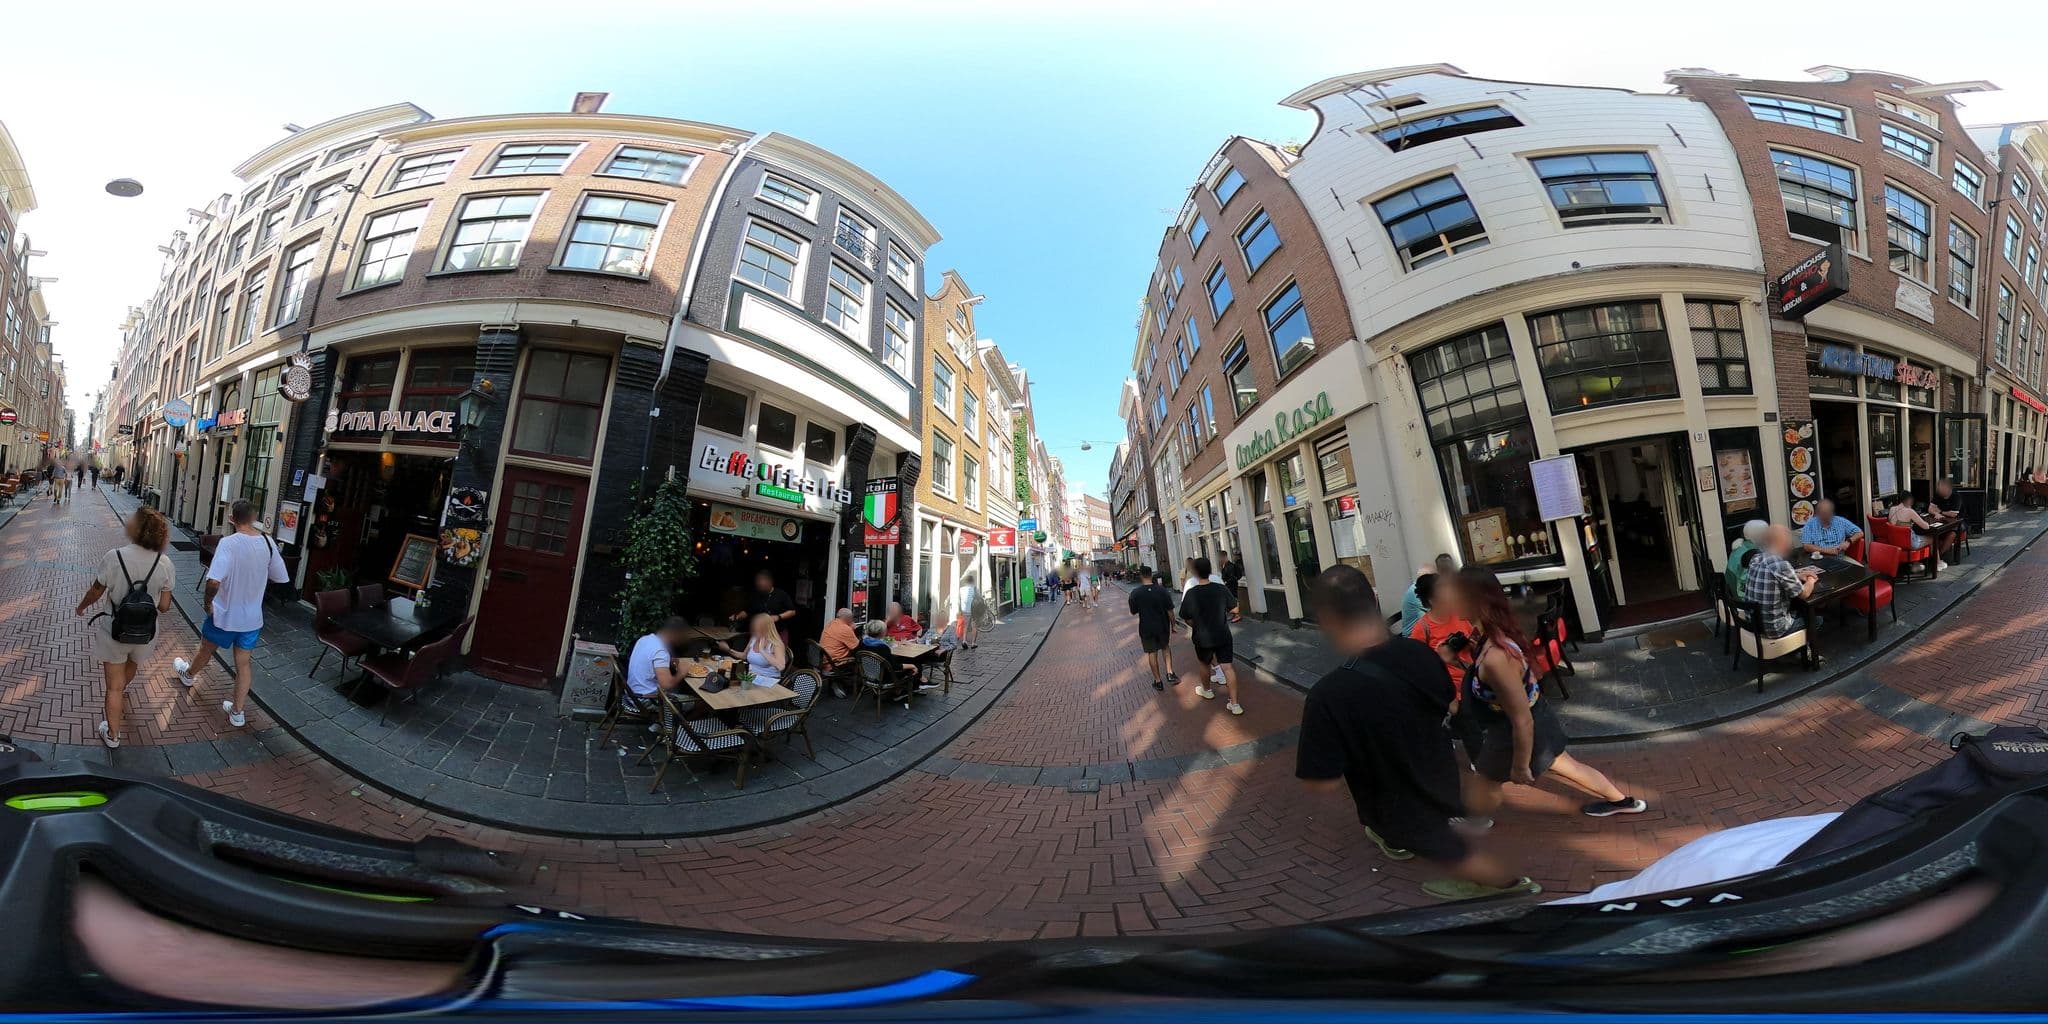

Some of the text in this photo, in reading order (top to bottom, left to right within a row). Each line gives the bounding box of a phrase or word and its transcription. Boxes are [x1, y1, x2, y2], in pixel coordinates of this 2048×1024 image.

[1781, 250, 1827, 284] STEAKHOUSE
[1782, 295, 1802, 312] MEXICAN
[339, 410, 456, 433] PITA PALACE
[1275, 391, 1333, 443] Rasa
[761, 484, 802, 502] Restaurant
[865, 481, 897, 492] italia
[741, 511, 780, 526] BREAKFAST
